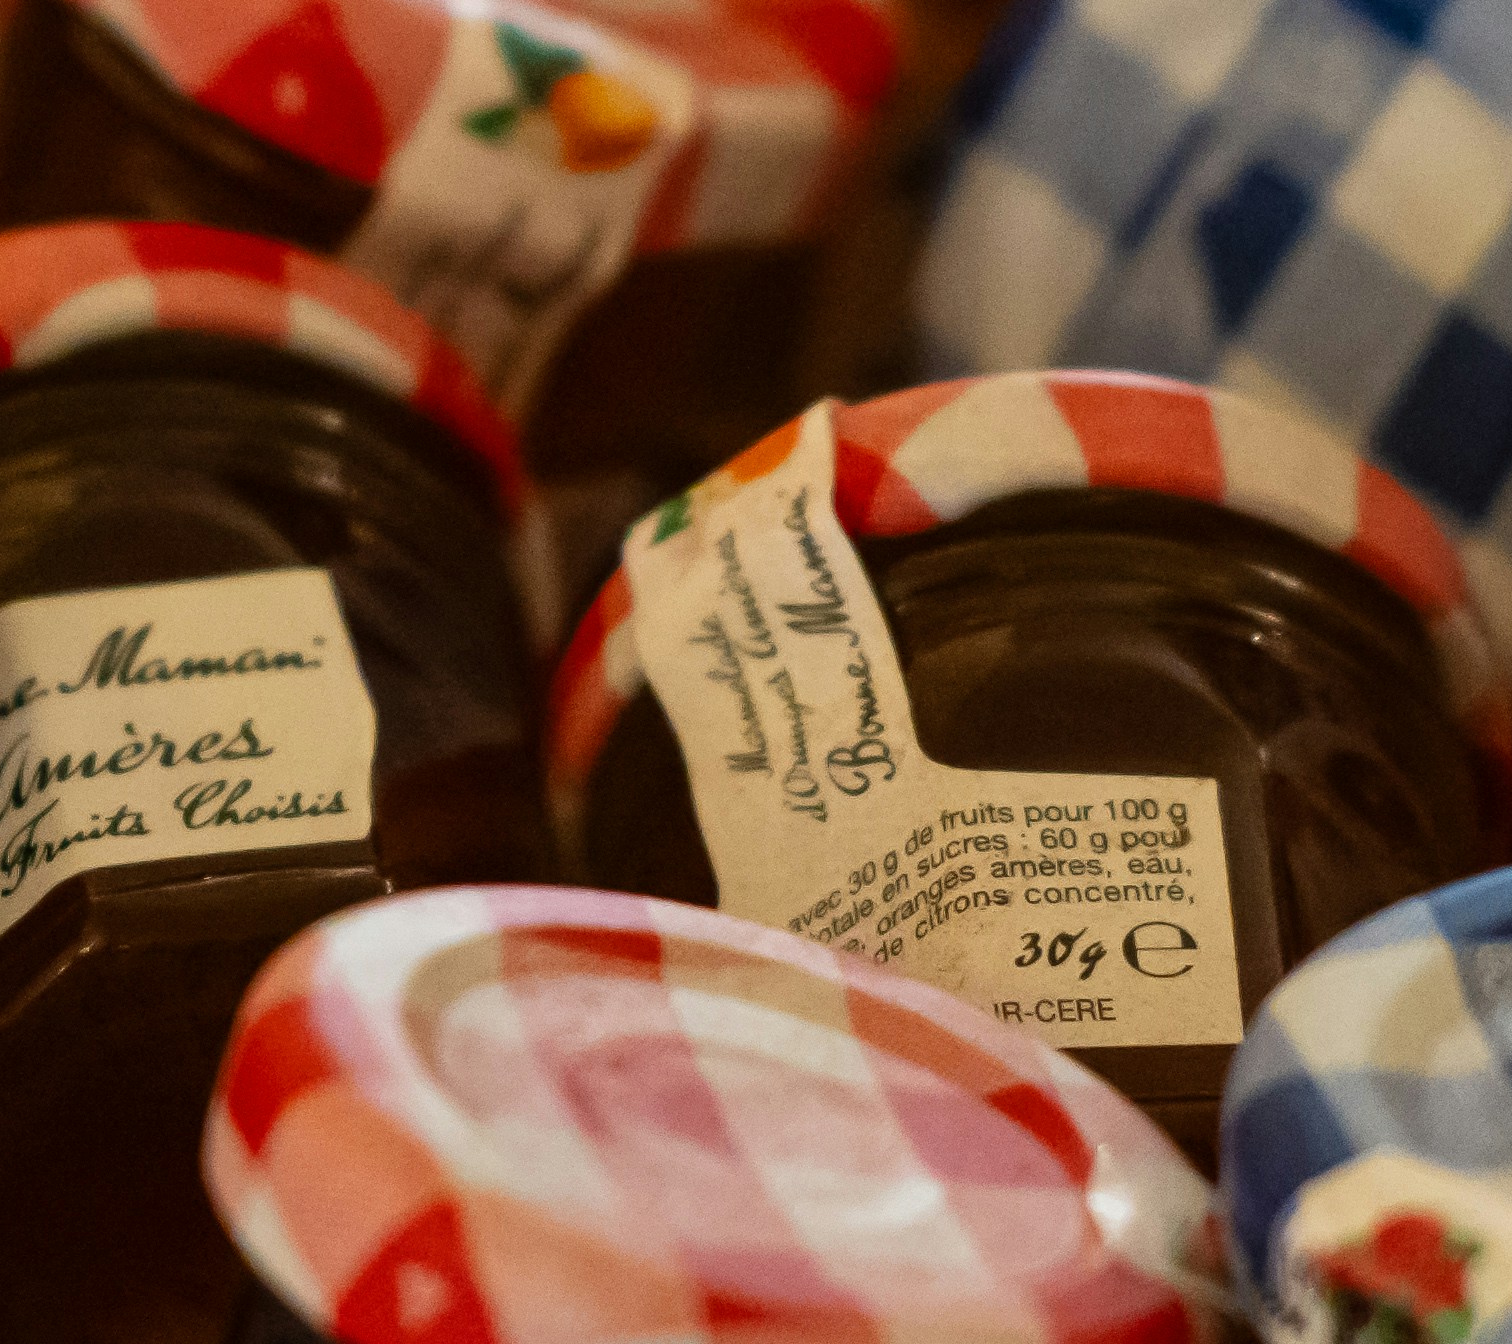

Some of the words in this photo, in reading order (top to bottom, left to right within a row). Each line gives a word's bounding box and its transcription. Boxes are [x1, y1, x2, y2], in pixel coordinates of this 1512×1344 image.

[826, 651, 896, 796] Bonne
[0, 797, 150, 898] Fruits
[174, 779, 349, 830] Choisis
[810, 898, 874, 943] otale
[882, 873, 909, 903] en
[917, 833, 1008, 878] sucres
[1040, 827, 1077, 849] 60
[1090, 832, 1109, 854] g
[849, 861, 876, 895] 30
[884, 850, 898, 876] g
[905, 826, 933, 855] de
[940, 802, 1014, 831] fruits
[1024, 805, 1093, 827] pour
[1104, 799, 1160, 821] 100
[1168, 803, 1188, 826] g
[874, 937, 903, 964] de
[915, 887, 1010, 940] citrons
[1024, 878, 1195, 905] concentré,
[877, 864, 976, 936] oranges
[990, 853, 1112, 878] amères,
[1128, 856, 1192, 877] eau,
[1014, 927, 1108, 981] 30g
